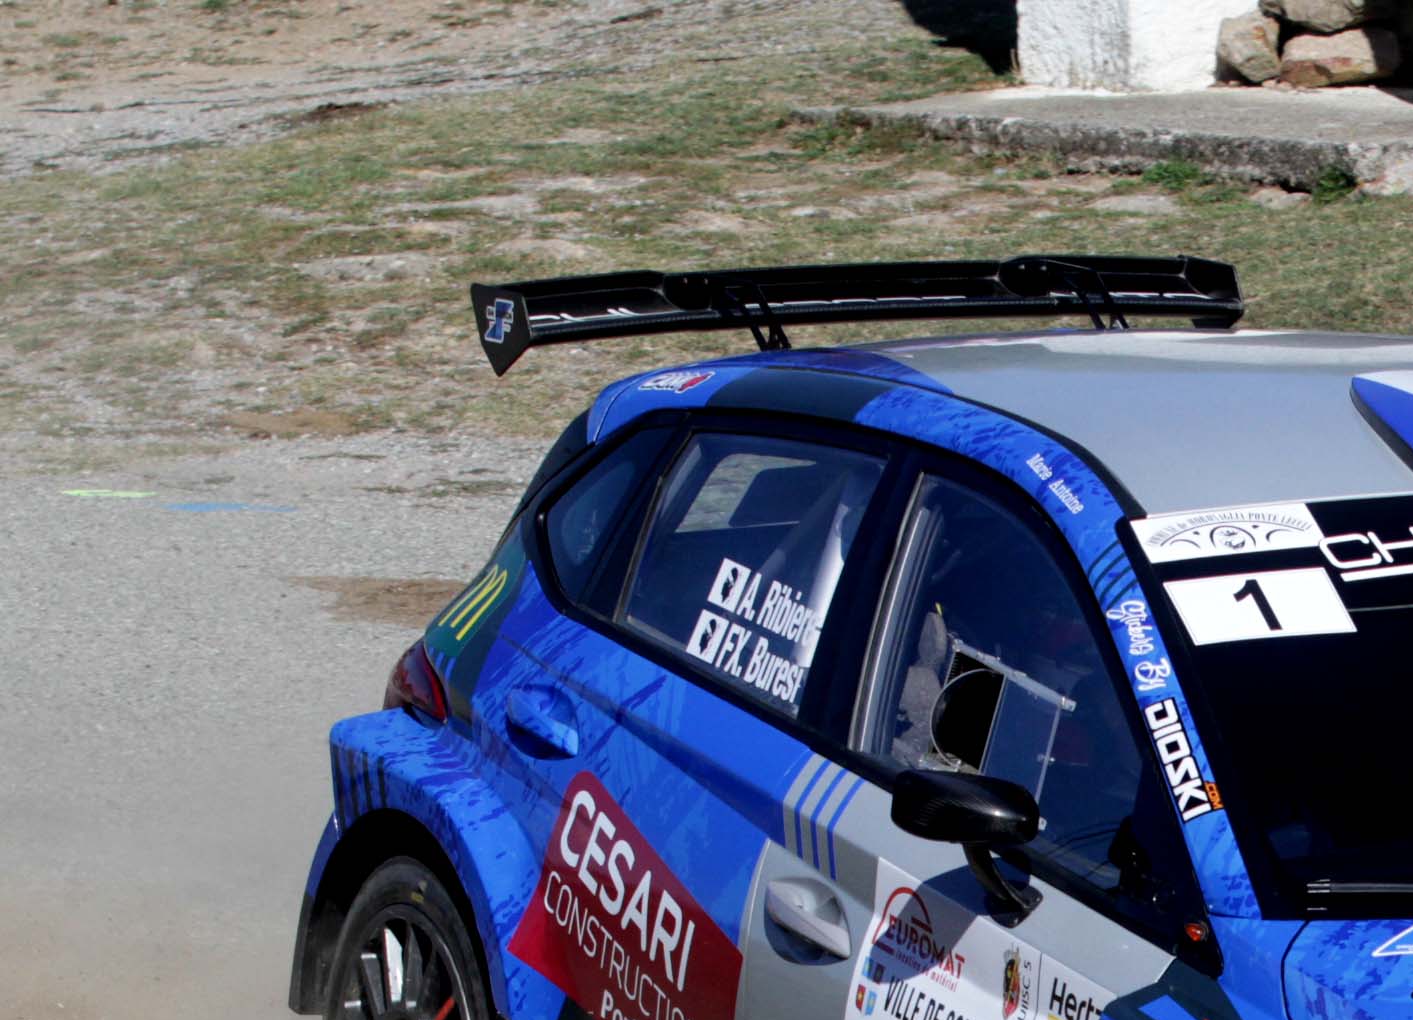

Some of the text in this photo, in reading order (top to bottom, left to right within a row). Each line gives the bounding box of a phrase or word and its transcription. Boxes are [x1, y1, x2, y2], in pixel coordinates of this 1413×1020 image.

[736, 572, 763, 622] A.
[1233, 579, 1283, 631] 1
[715, 623, 754, 678] FX.
[1135, 657, 1171, 691] By
[1144, 697, 1213, 822] DIOSKI
[560, 789, 696, 992] CESARI
[885, 914, 966, 980] EUROMAT
